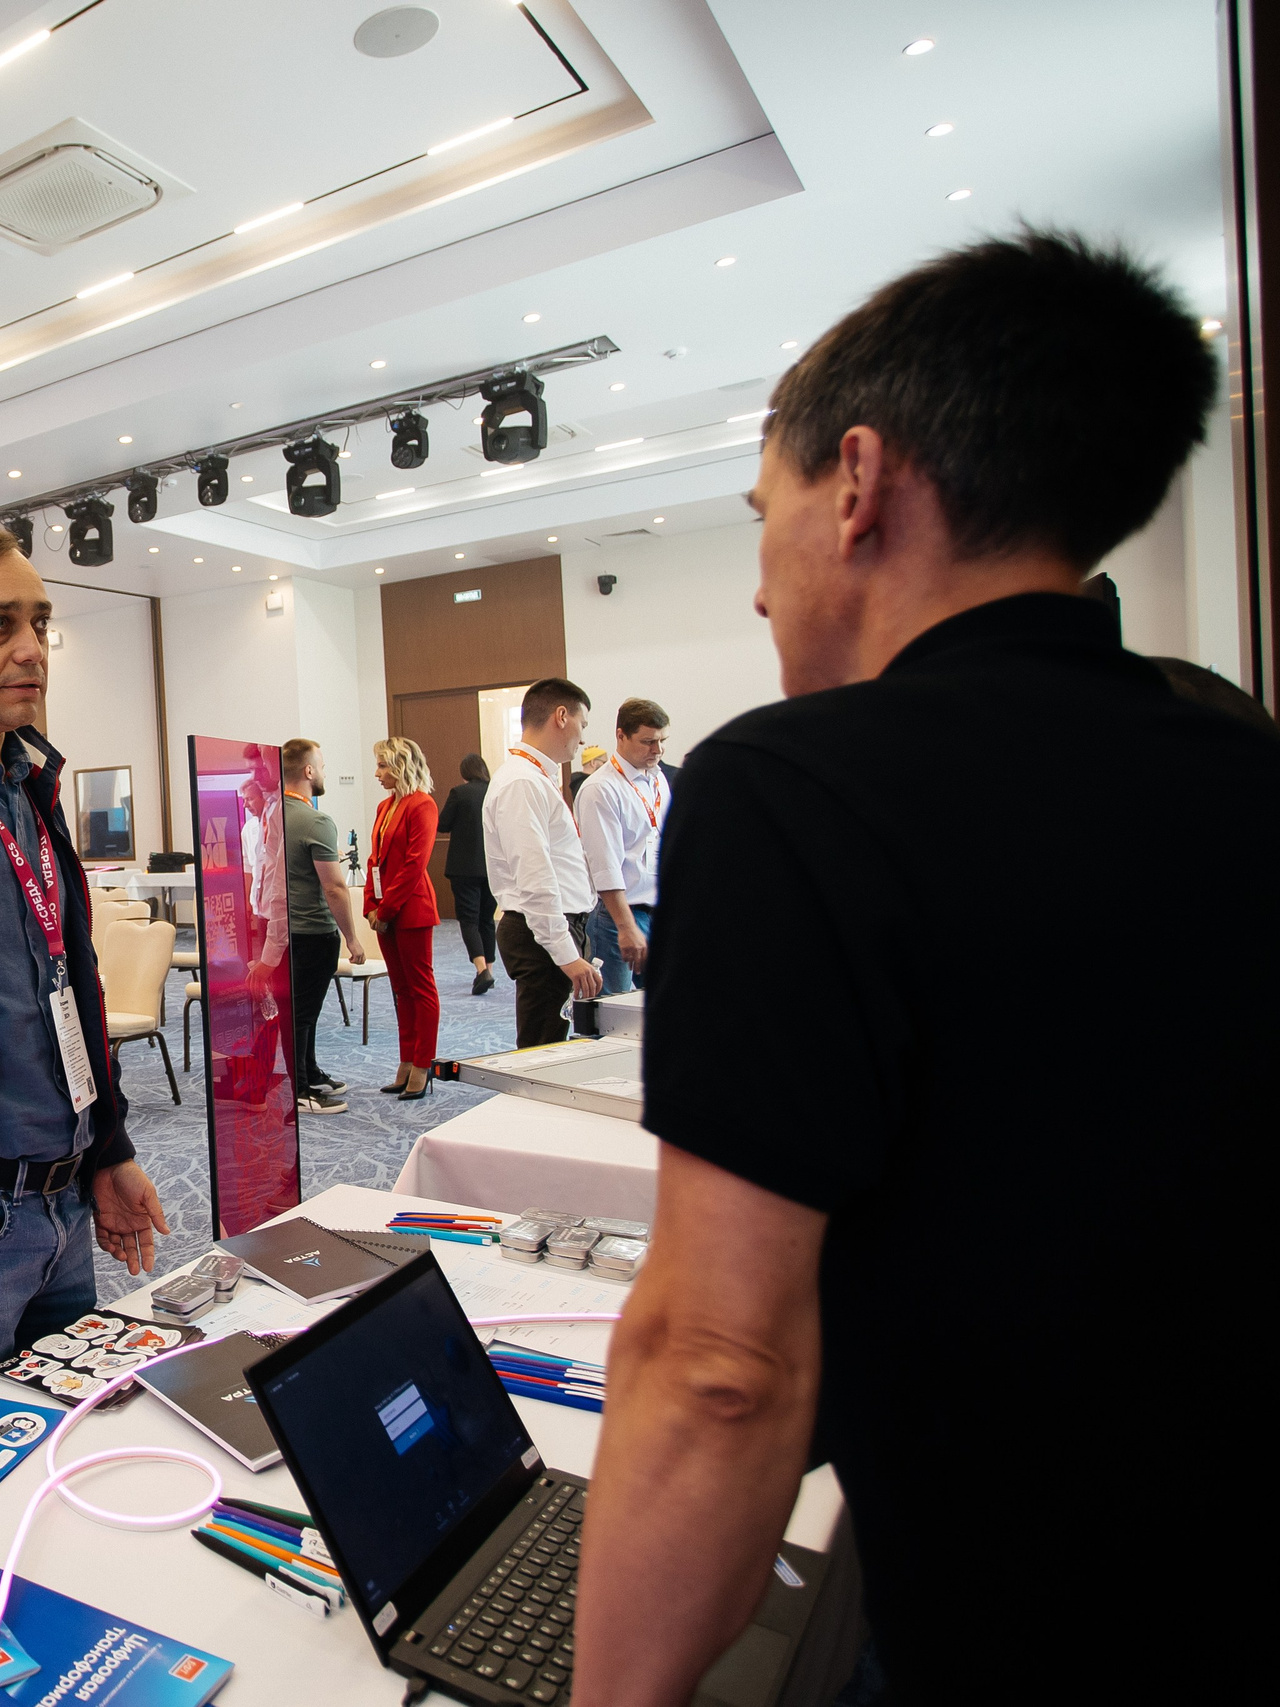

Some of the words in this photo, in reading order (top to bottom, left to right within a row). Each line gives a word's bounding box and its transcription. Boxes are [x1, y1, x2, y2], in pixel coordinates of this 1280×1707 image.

[7, 841, 24, 868] OCS
[220, 1388, 252, 1402] ТРА
[34, 1627, 127, 1707] трансформа
[75, 1633, 149, 1702] Цифровая
